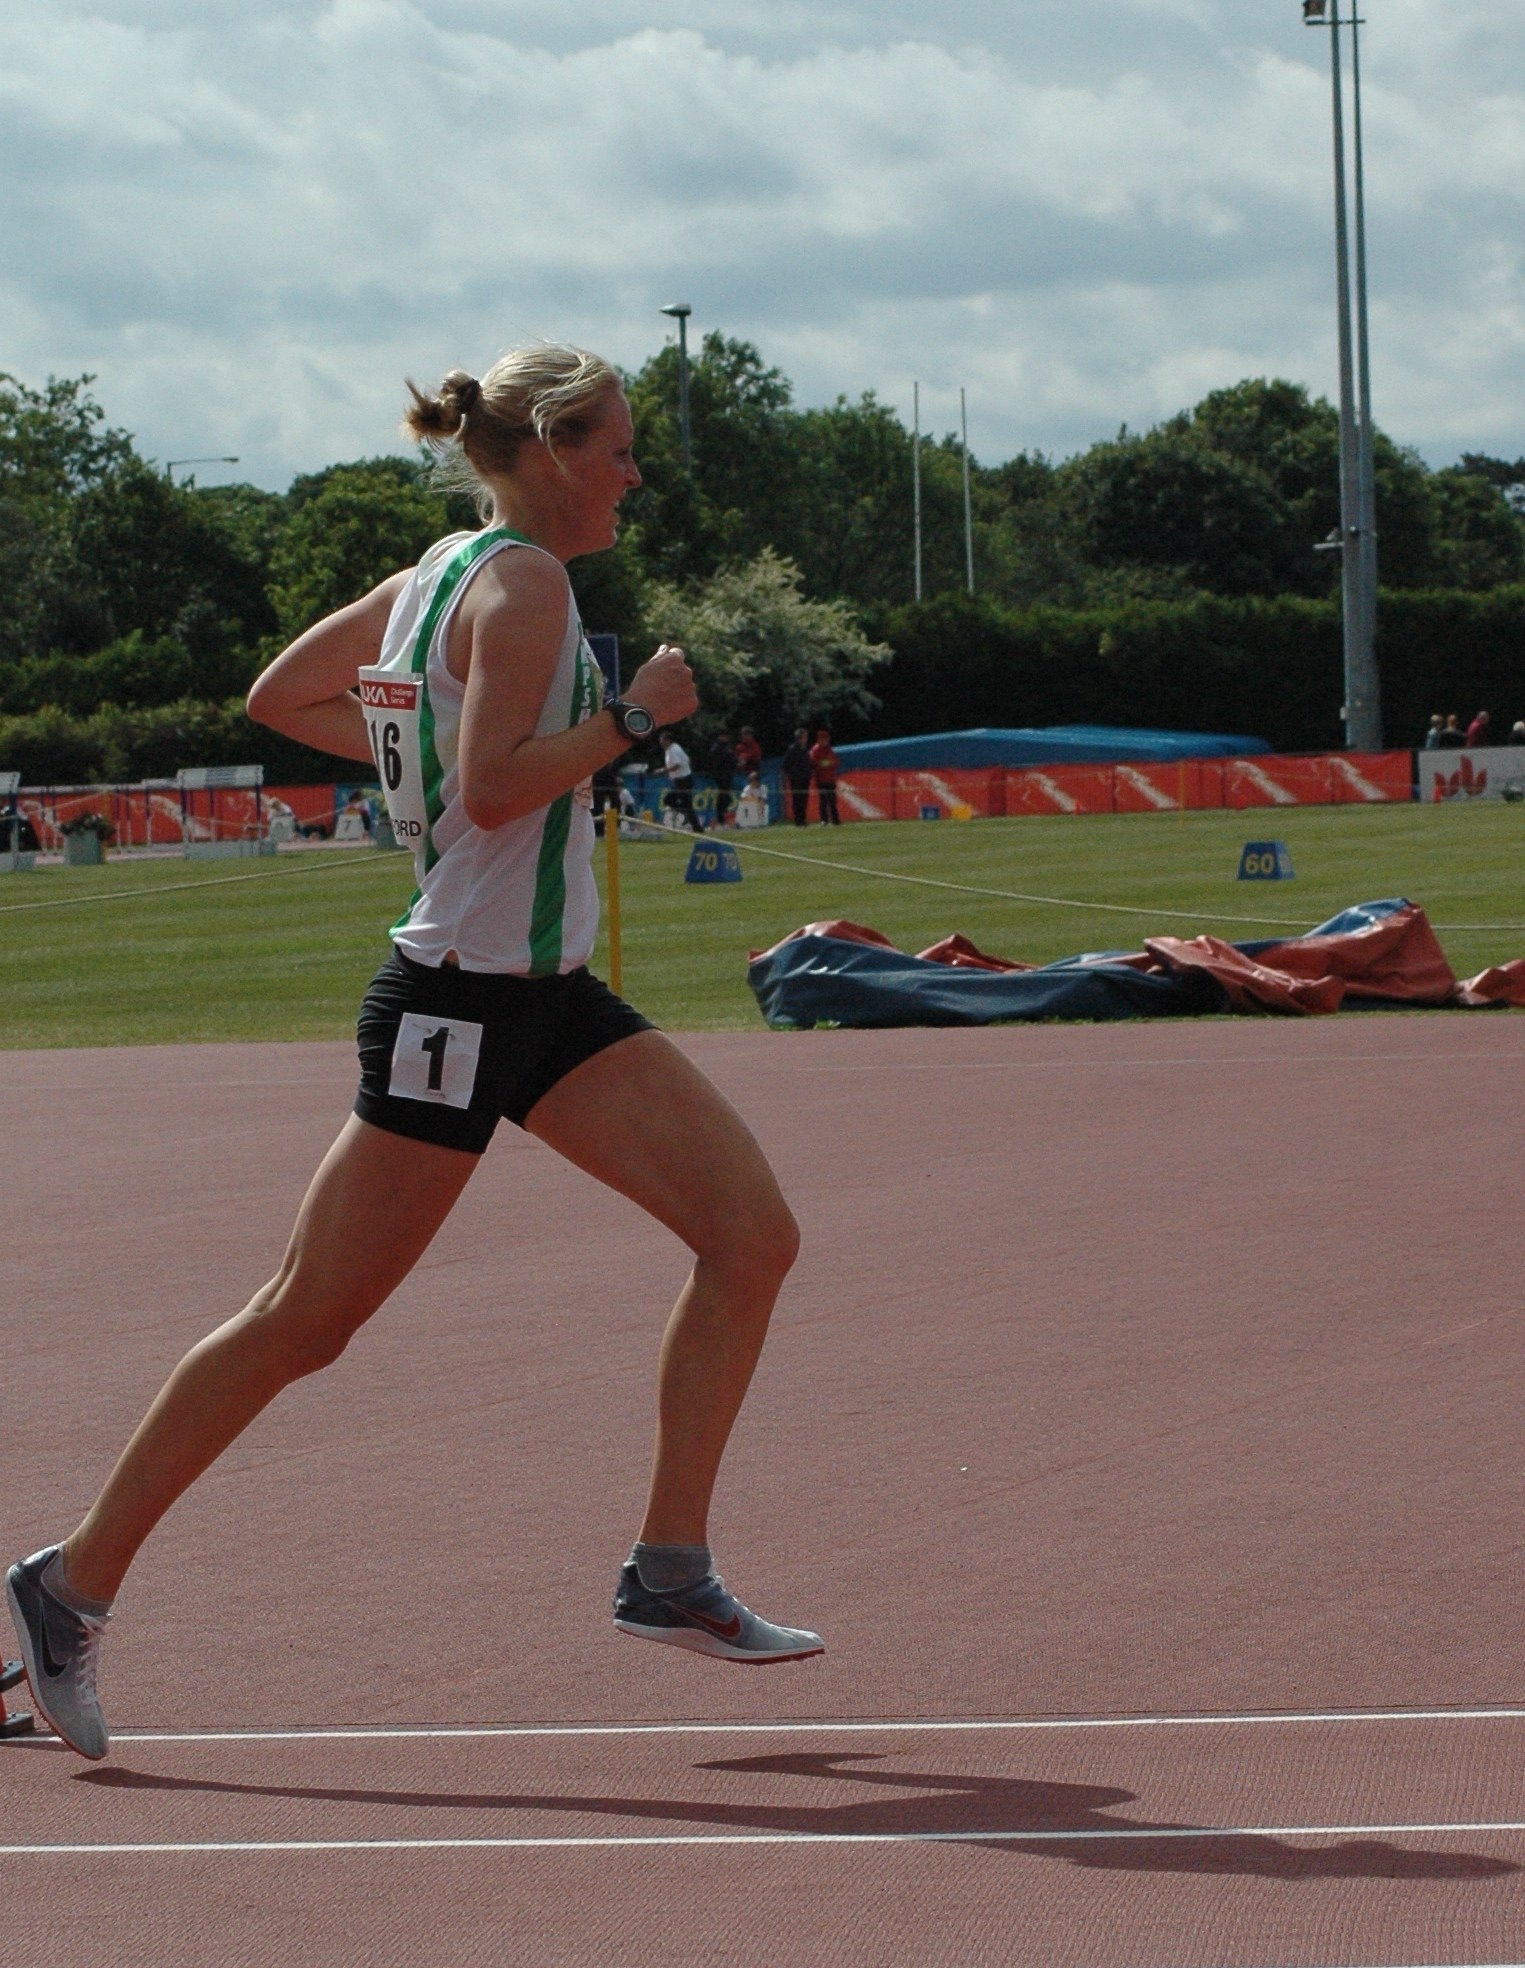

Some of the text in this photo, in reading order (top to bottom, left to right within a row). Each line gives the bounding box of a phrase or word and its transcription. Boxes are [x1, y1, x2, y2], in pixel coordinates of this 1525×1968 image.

[695, 852, 718, 872] 70
[1245, 852, 1275, 875] 60
[421, 1026, 451, 1091] 1
